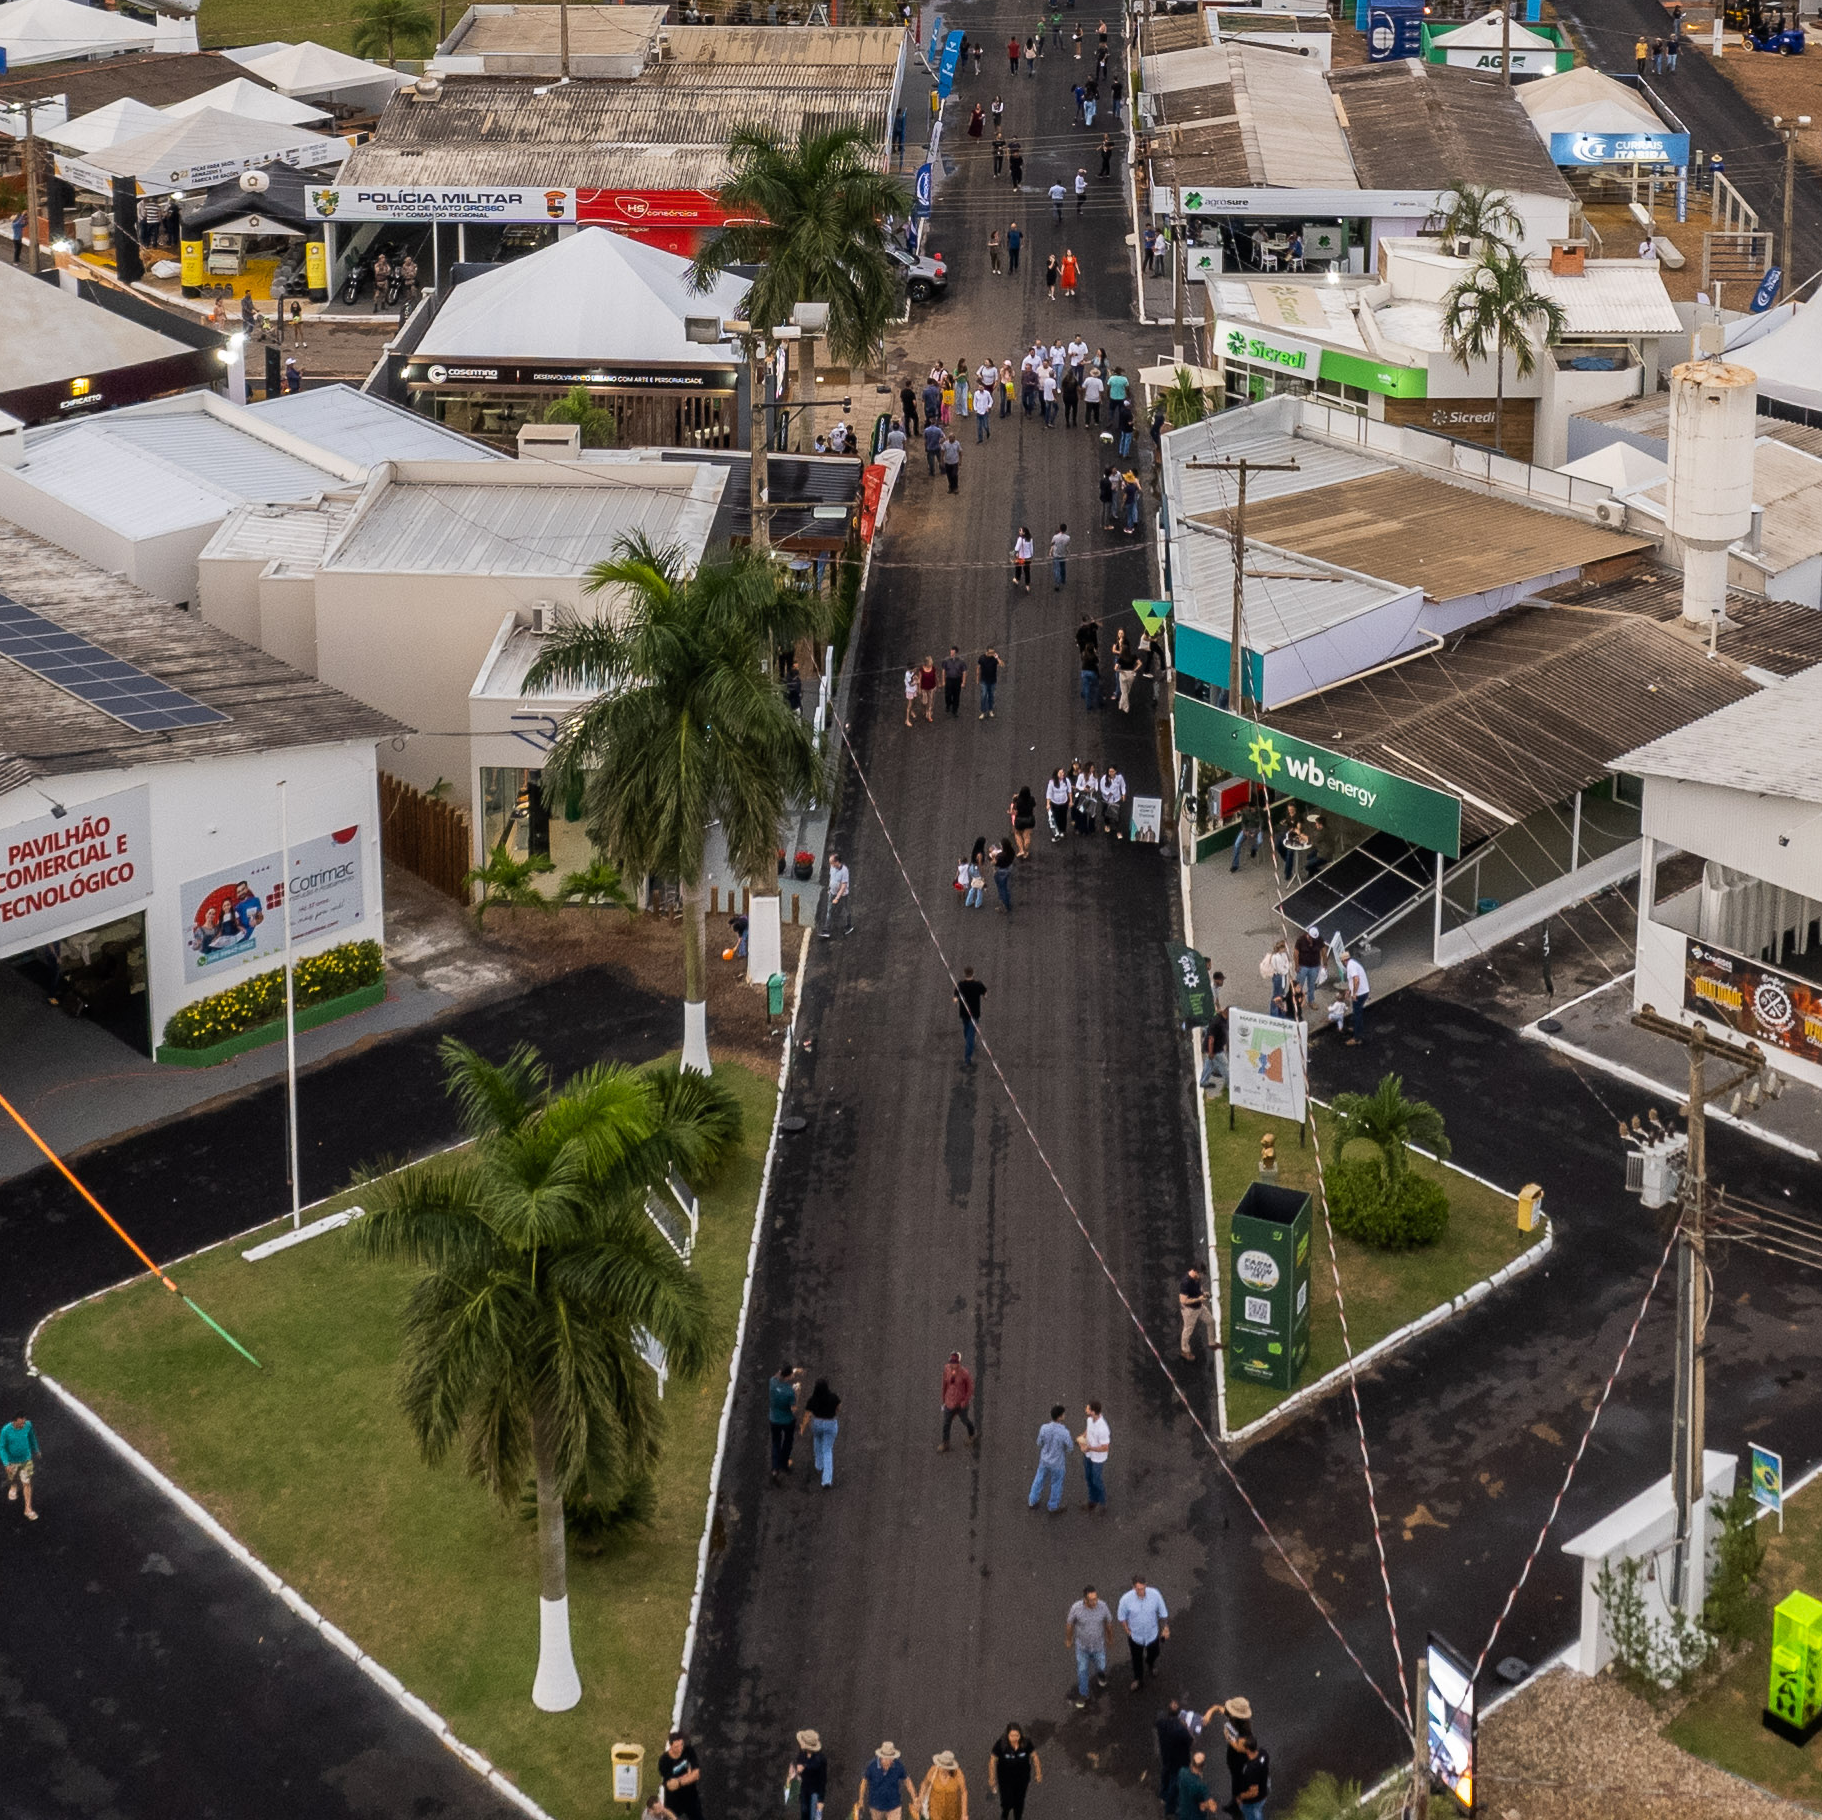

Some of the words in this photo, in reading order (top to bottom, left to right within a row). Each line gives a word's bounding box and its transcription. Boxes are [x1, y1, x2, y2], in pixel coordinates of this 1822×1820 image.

[1615, 140, 1662, 150] CURRAIS
[1615, 150, 1669, 161] ITABIRA
[358, 189, 436, 205] POLÍCIA
[441, 193, 523, 205] MILITAR
[1205, 199, 1249, 208] agrosure
[432, 204, 461, 212] MATO
[627, 204, 645, 213] HS
[647, 209, 698, 217] consórcios
[1248, 339, 1307, 370] Sicredi
[448, 369, 498, 377] COSENTINO
[533, 373, 591, 382] DESENVOLVIMENTO
[60, 393, 102, 408] EDIFICATTO
[1450, 411, 1495, 424] Sicredi
[1285, 756, 1325, 787] wb
[1326, 777, 1377, 808] energy
[8, 815, 110, 866] PAVILHÃO
[116, 833, 127, 855] E
[289, 861, 354, 895] Cotrimac
[1239, 1015, 1258, 1024] MAPA
[1259, 1018, 1267, 1026] DO
[1268, 1020, 1293, 1031] PARQUE
[1244, 1256, 1273, 1271] FARM
[1244, 1263, 1274, 1278] SHOW
[1251, 1271, 1266, 1281] MT
